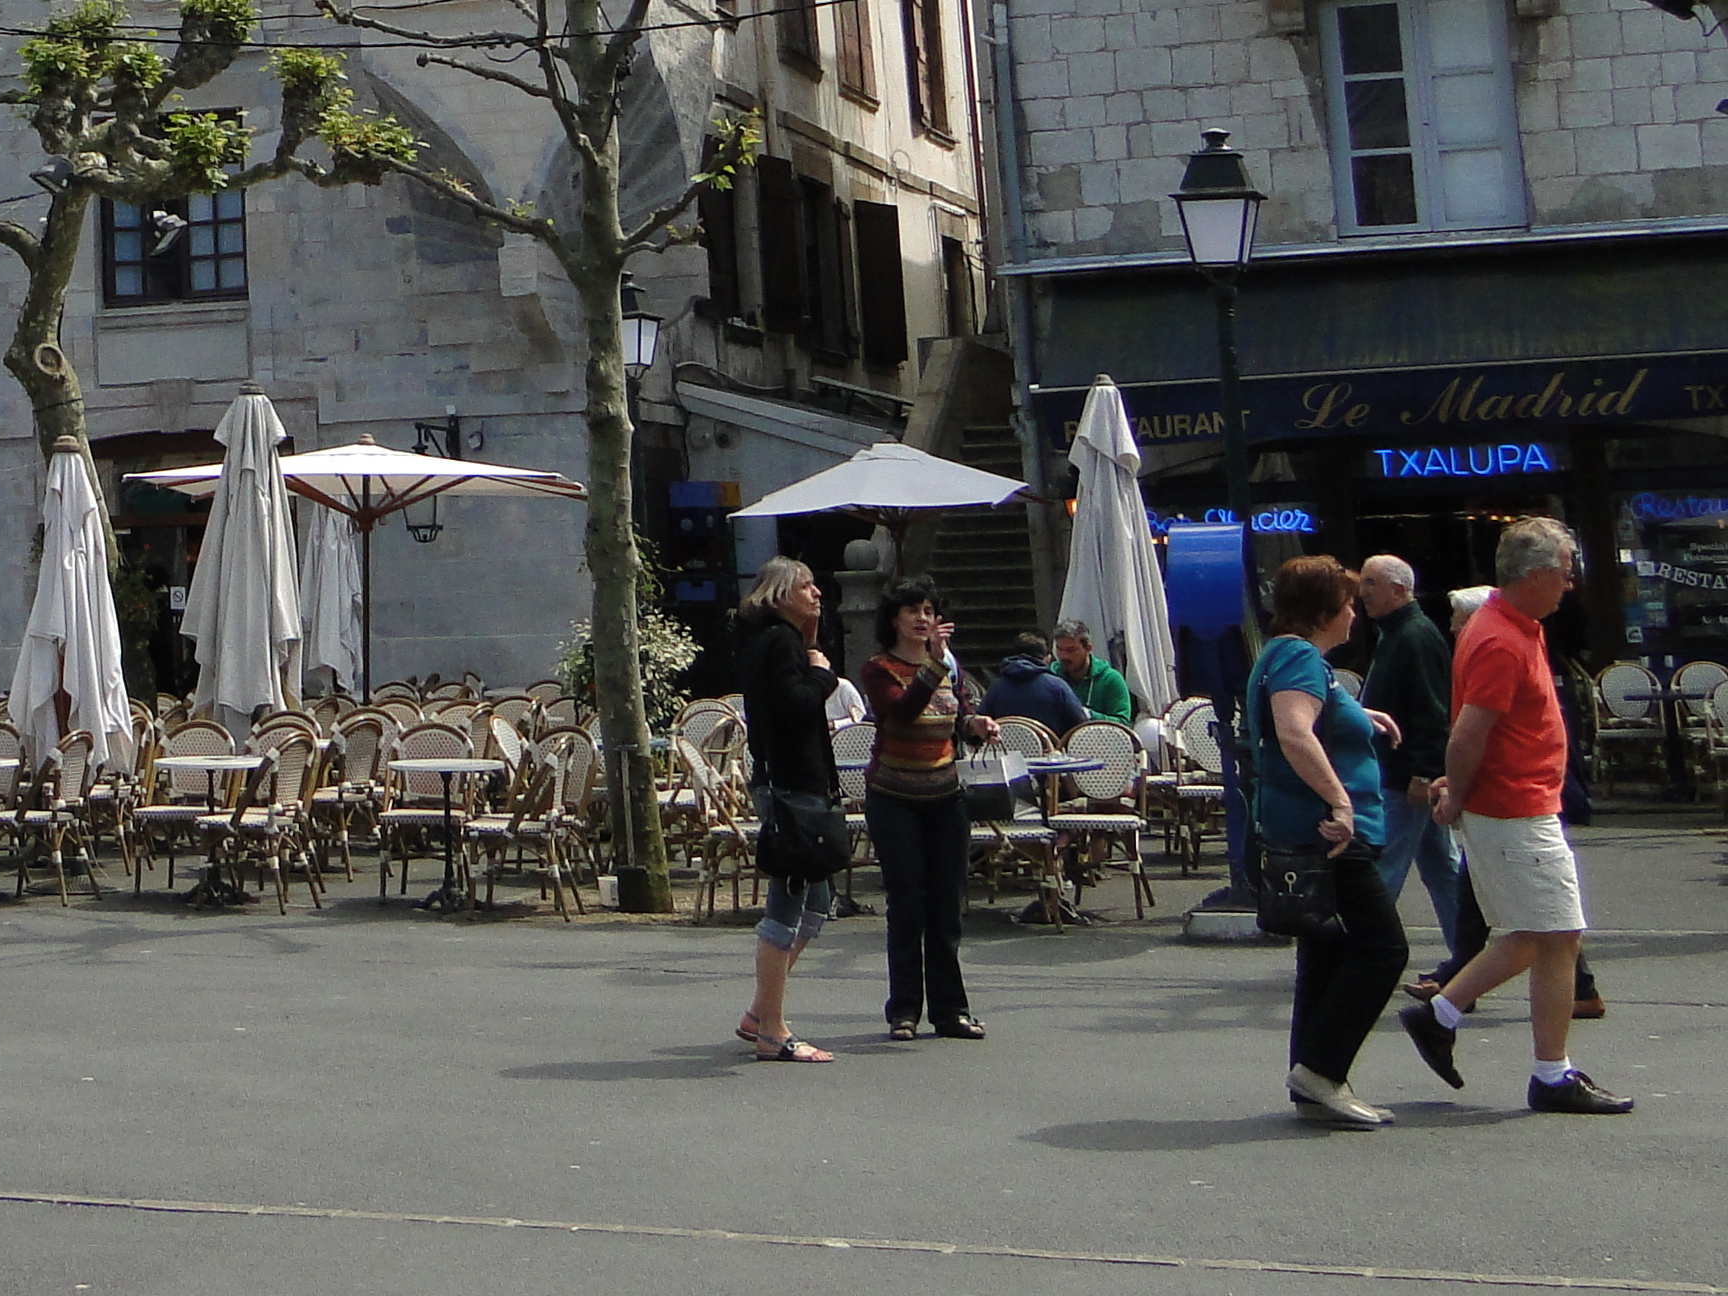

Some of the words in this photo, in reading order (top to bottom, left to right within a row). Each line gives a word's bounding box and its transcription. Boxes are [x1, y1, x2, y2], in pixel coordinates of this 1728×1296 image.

[1294, 382, 1371, 430] Le
[1400, 368, 1648, 425] Madrid
[1374, 443, 1551, 477] TXALUPA
[1654, 561, 1728, 590] RESTA
